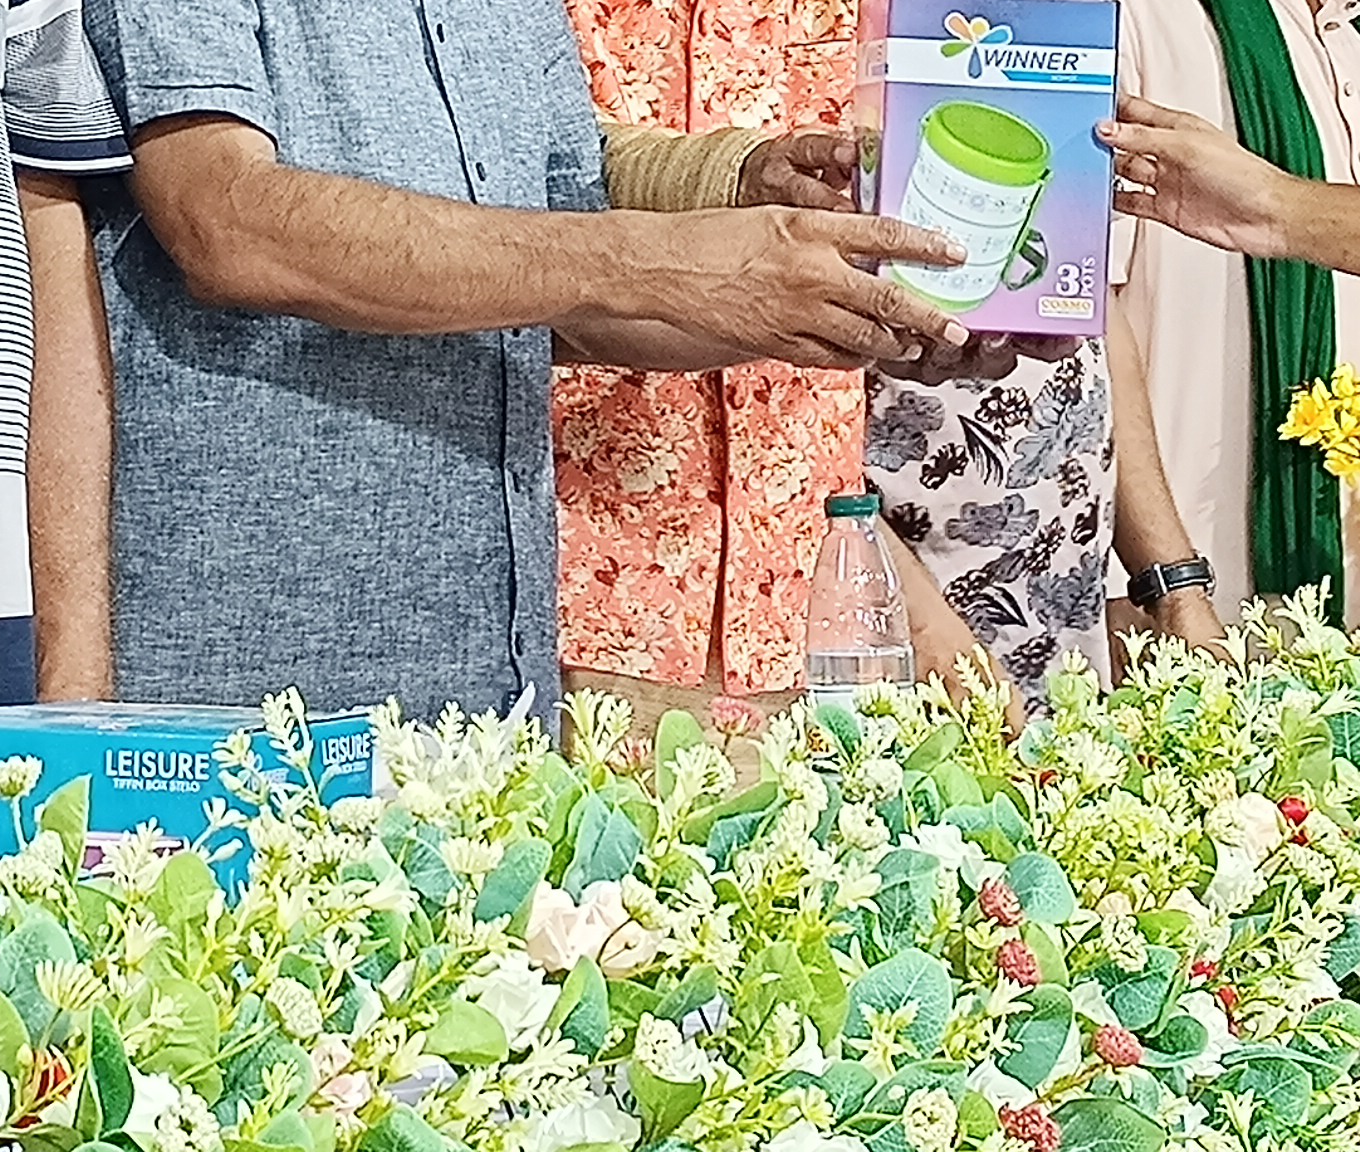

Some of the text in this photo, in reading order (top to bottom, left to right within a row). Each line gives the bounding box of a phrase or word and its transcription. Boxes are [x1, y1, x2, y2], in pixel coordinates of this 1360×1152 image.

[984, 49, 1079, 70] WINNER
[1056, 264, 1080, 296] 3
[1041, 298, 1092, 311] COSMO
[322, 733, 370, 765] LEISURE
[105, 748, 210, 780] LEISURE
[145, 779, 168, 791] BOX
